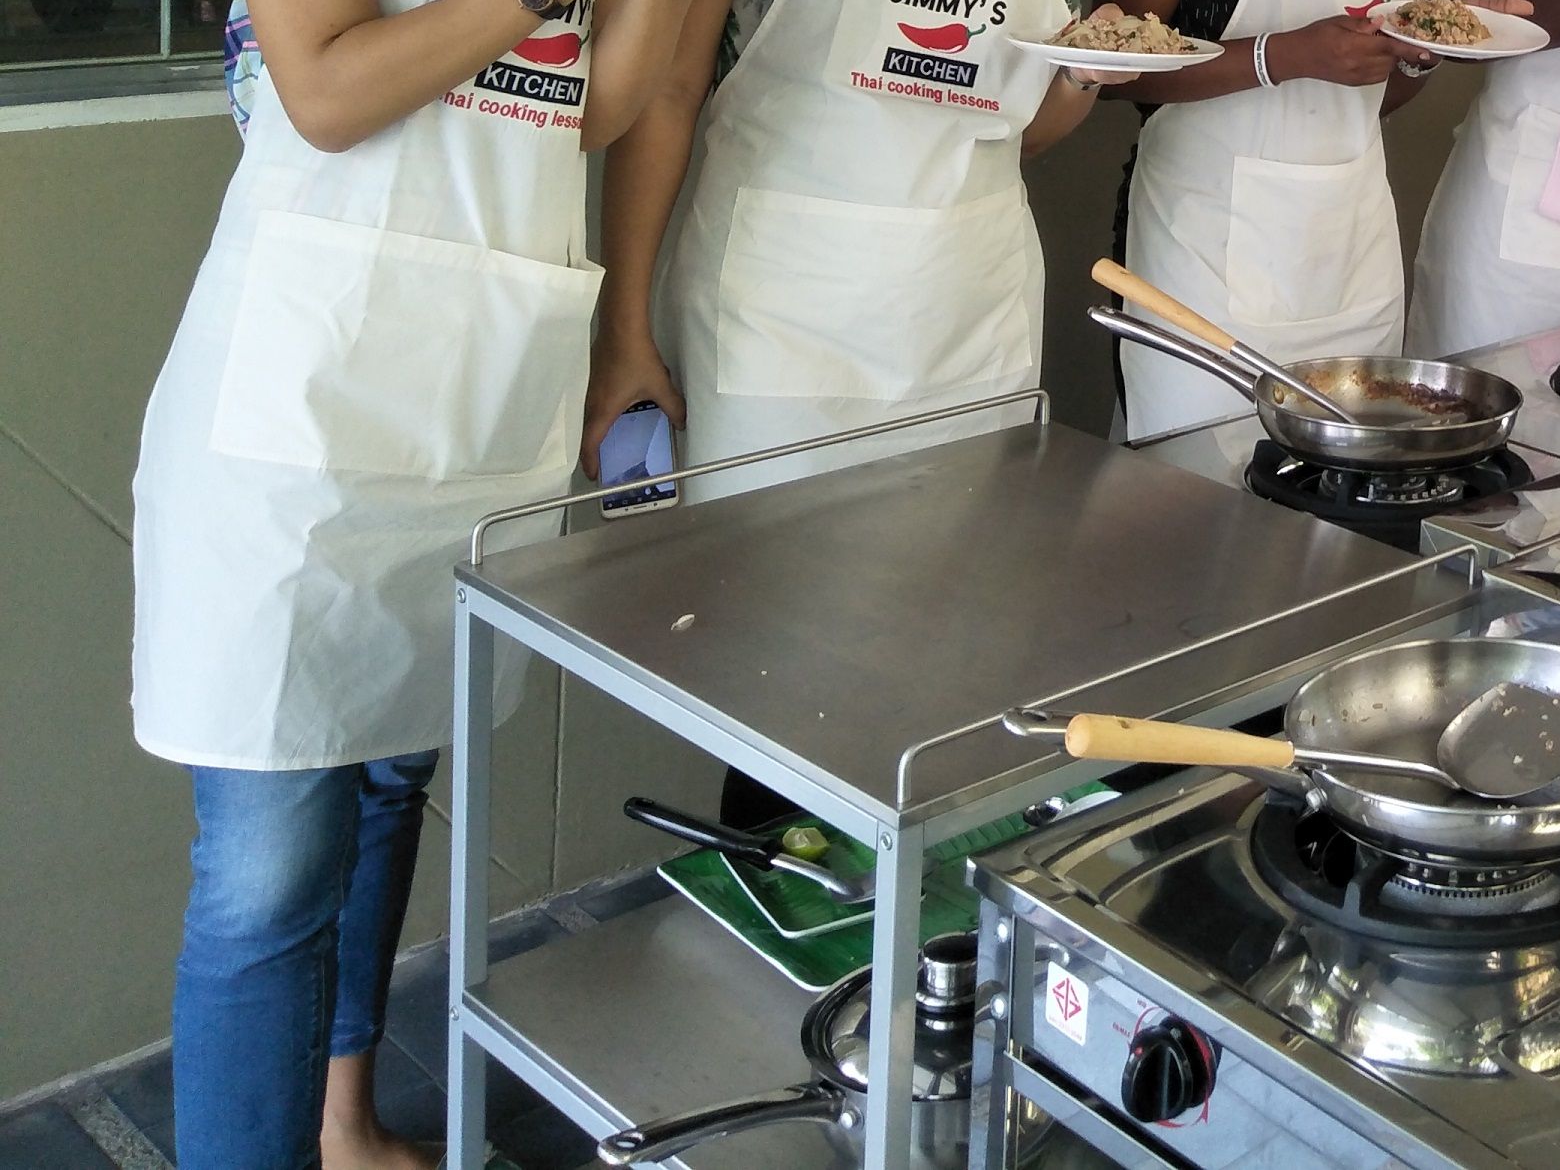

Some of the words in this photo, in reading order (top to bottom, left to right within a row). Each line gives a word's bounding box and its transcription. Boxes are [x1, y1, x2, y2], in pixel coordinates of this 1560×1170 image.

[484, 65, 580, 103] KITCHEN
[888, 52, 972, 84] KITCHEN
[440, 90, 474, 110] hai
[478, 98, 548, 128] cooking
[551, 110, 583, 130] lesso
[851, 72, 883, 90] Thai
[887, 81, 943, 103] cooking
[948, 89, 1000, 111] lessons
